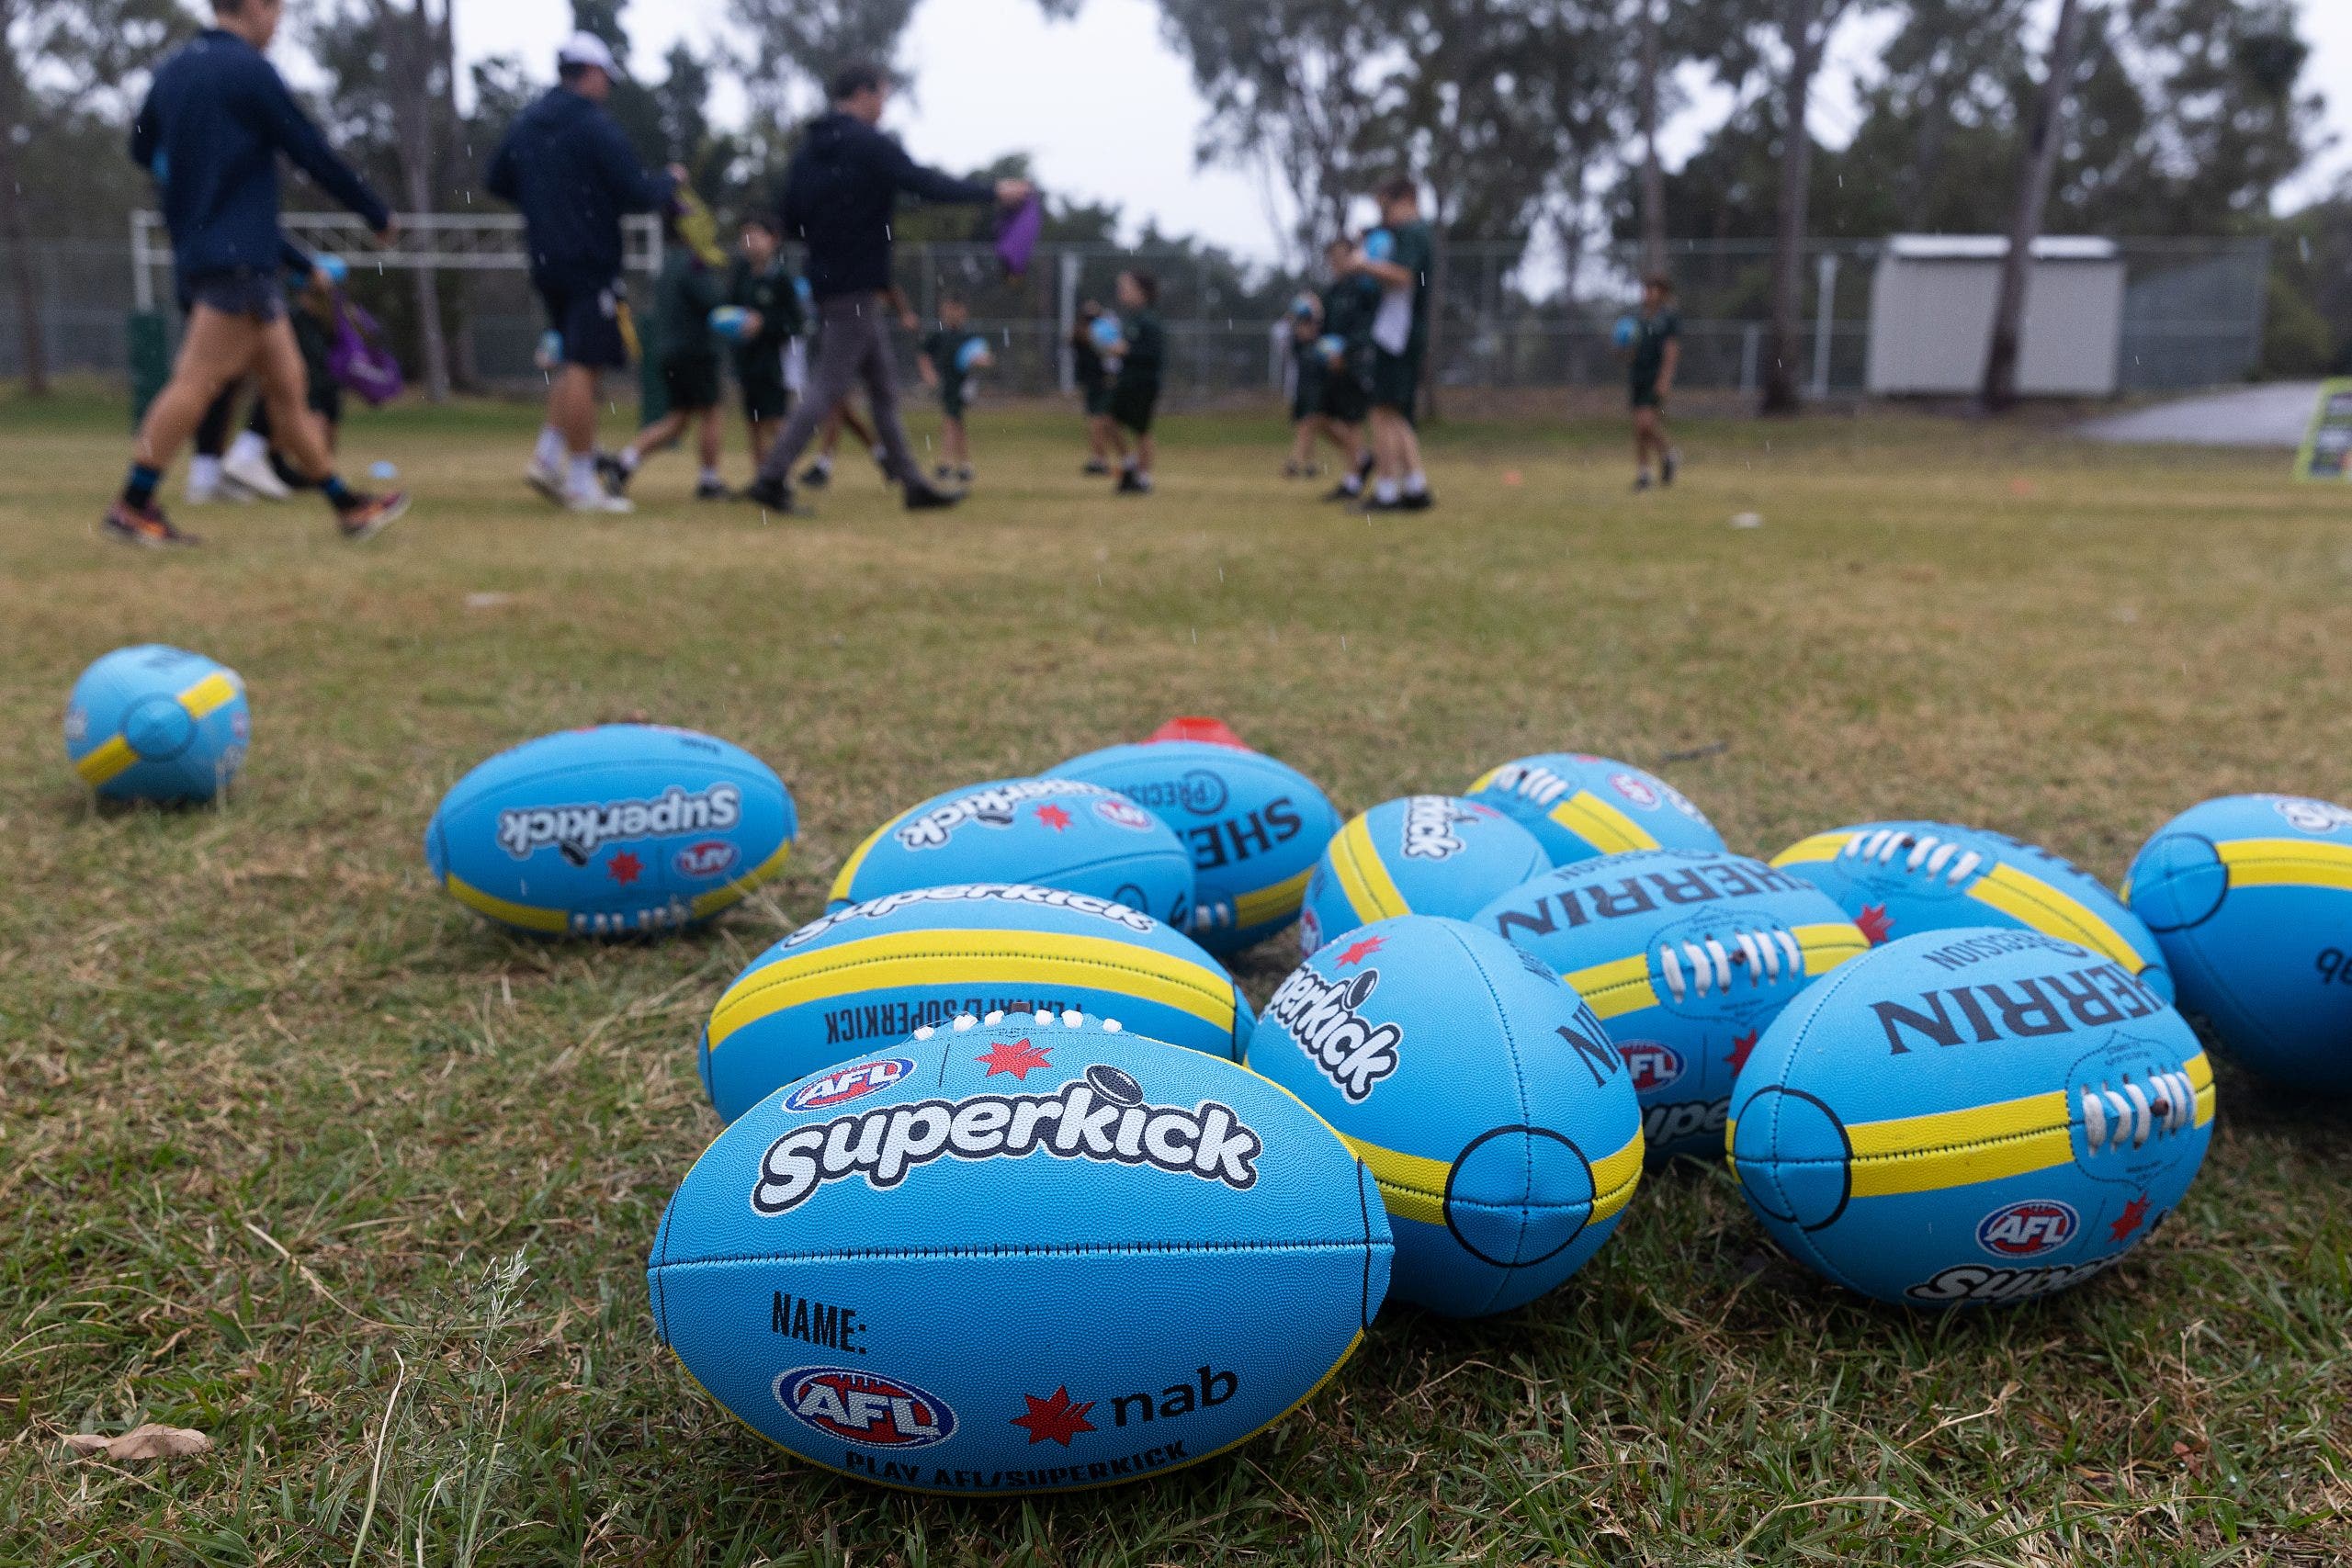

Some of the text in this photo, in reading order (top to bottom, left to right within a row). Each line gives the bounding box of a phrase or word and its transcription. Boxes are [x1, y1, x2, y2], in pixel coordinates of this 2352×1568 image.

[499, 784, 740, 859] Superkick
[1179, 797, 1302, 871] SHE
[1868, 961, 2170, 1056] HERRIN
[791, 1062, 904, 1109] AFL
[1624, 1050, 1679, 1083] FL
[752, 1075, 1262, 1215] Superkick
[1981, 1212, 2070, 1247] AFL
[771, 1290, 868, 1356] NAME:
[792, 1378, 944, 1438] AFL
[1111, 1363, 1238, 1428] nab
[845, 1450, 922, 1483] PLAY
